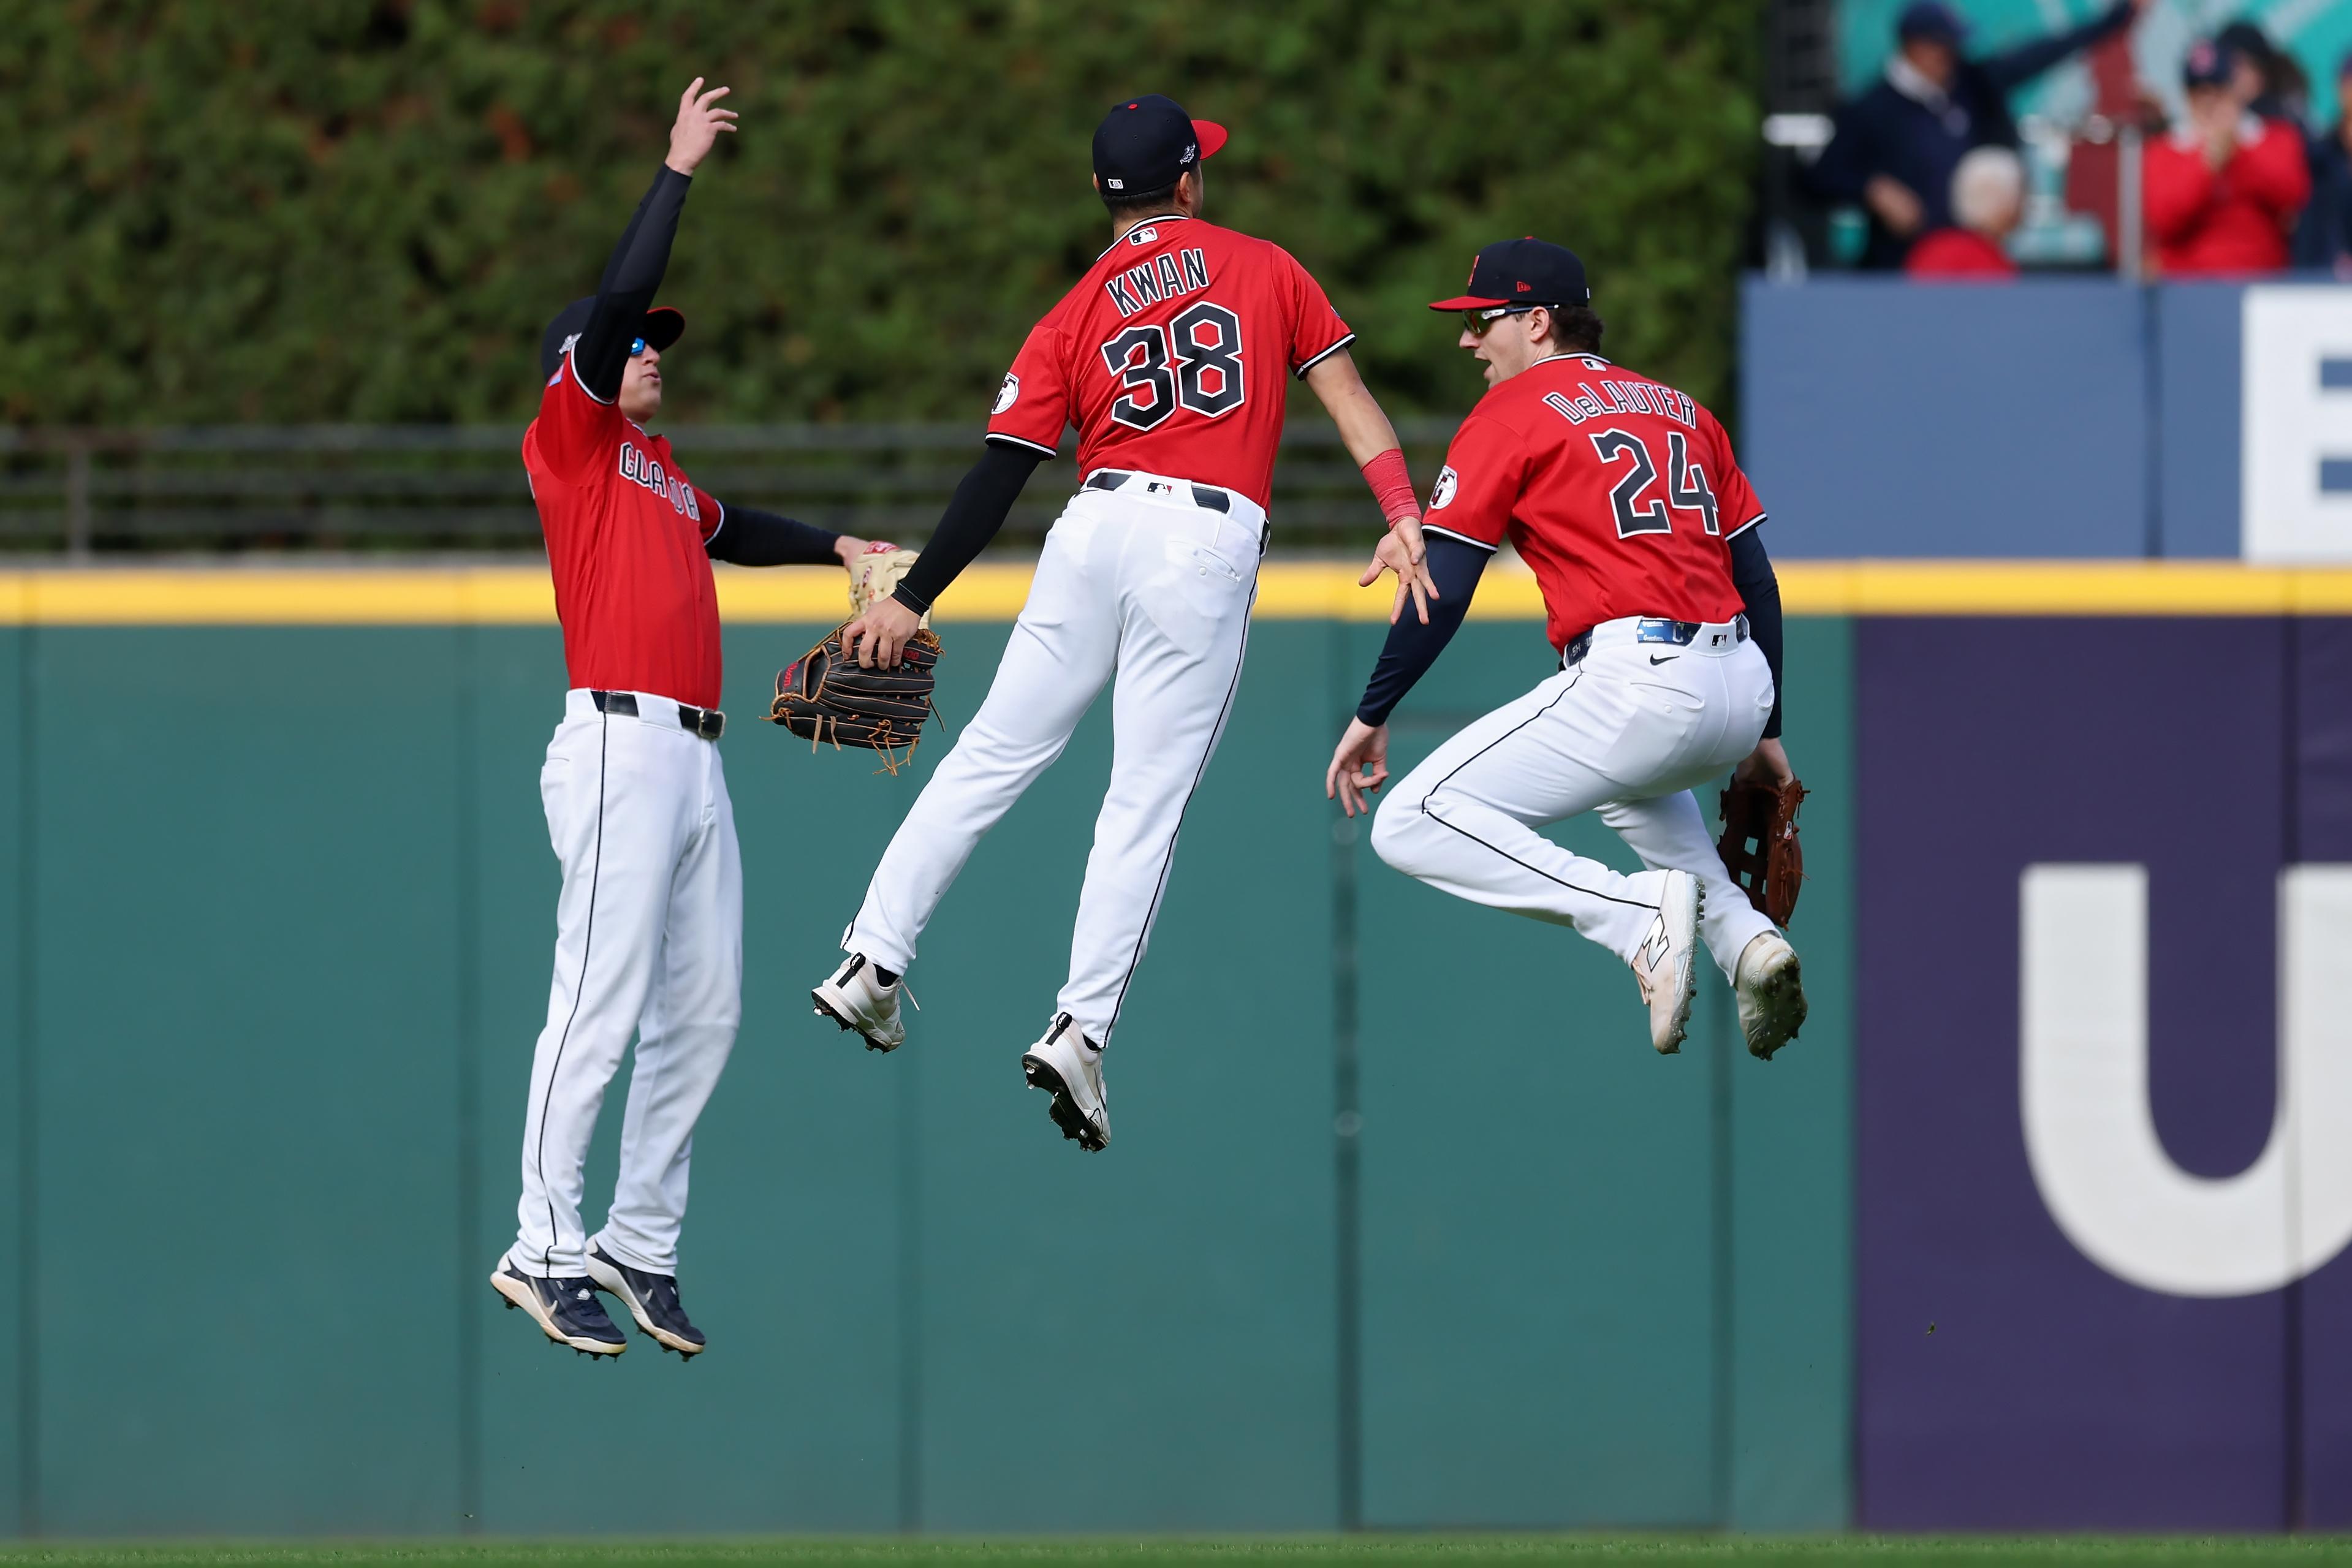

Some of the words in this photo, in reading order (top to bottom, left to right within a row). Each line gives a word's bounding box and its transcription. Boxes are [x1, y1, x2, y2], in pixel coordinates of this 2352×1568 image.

[1105, 248, 1209, 318] KWAN
[1101, 301, 1245, 431] 38
[1542, 380, 1696, 430] DeLAUTER
[1588, 428, 1721, 539] 24
[2019, 861, 2352, 1298] U
